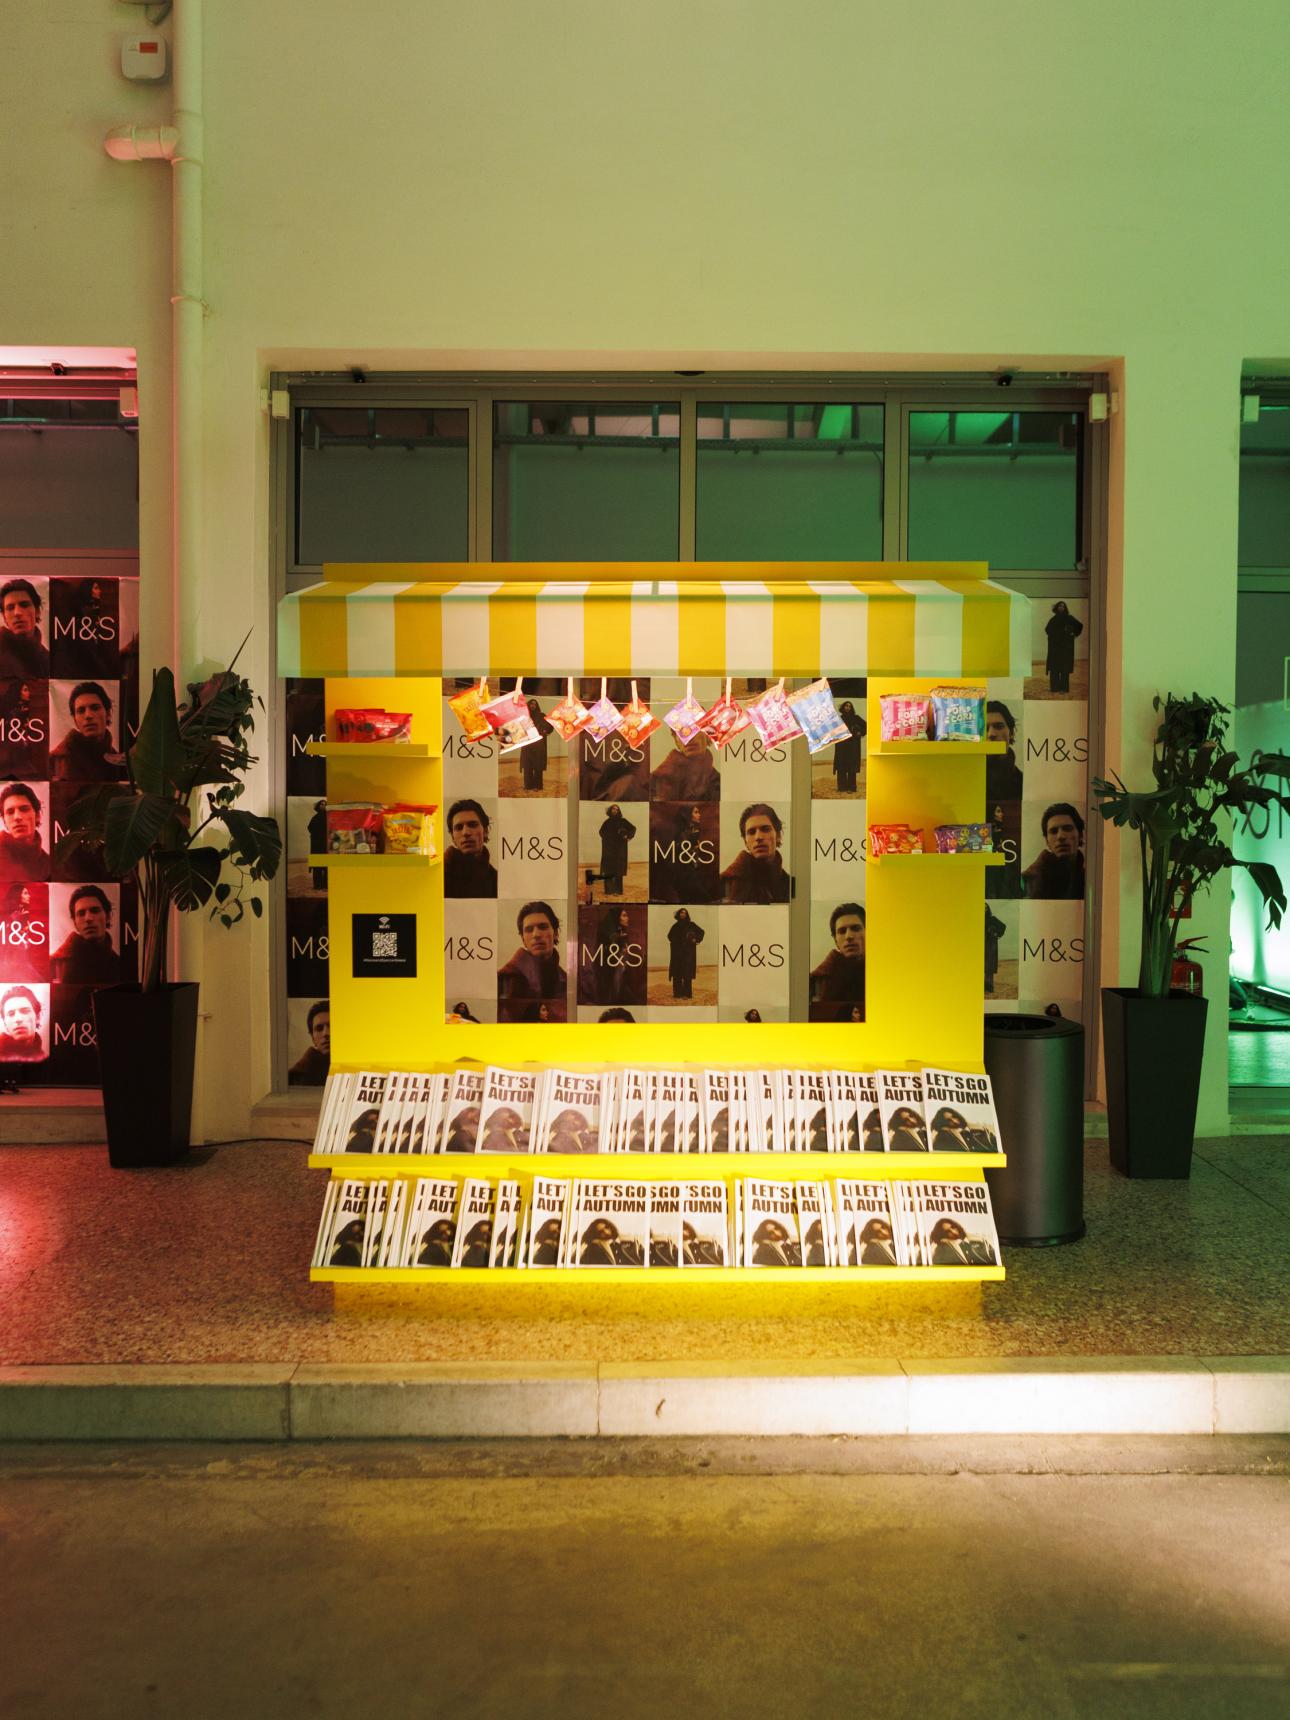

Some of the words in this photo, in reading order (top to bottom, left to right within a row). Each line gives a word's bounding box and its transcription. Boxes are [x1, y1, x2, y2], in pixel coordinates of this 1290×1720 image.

[54, 616, 116, 640] M&S
[0, 718, 45, 742] &S
[1026, 738, 1088, 762] M&S
[501, 836, 564, 861] M&S
[654, 840, 715, 864] M&S
[582, 943, 643, 967] M&S
[722, 943, 785, 967] M&S
[1023, 938, 1083, 963] M&S
[490, 1072, 529, 1089] LET'S
[556, 1074, 594, 1091] LET'S
[926, 1072, 964, 1090] LET'S
[966, 1077, 987, 1091] GO
[927, 1087, 990, 1105] AUTUMN
[585, 1184, 623, 1198] LET'S
[625, 1185, 647, 1198] GO
[658, 1186, 680, 1198] GO
[701, 1186, 722, 1198] GO
[752, 1183, 789, 1199] LET'S
[924, 1184, 962, 1199] LET'S
[964, 1186, 986, 1200] GO
[583, 1199, 646, 1213] AUTUMN
[926, 1199, 989, 1214] AUTUMN
